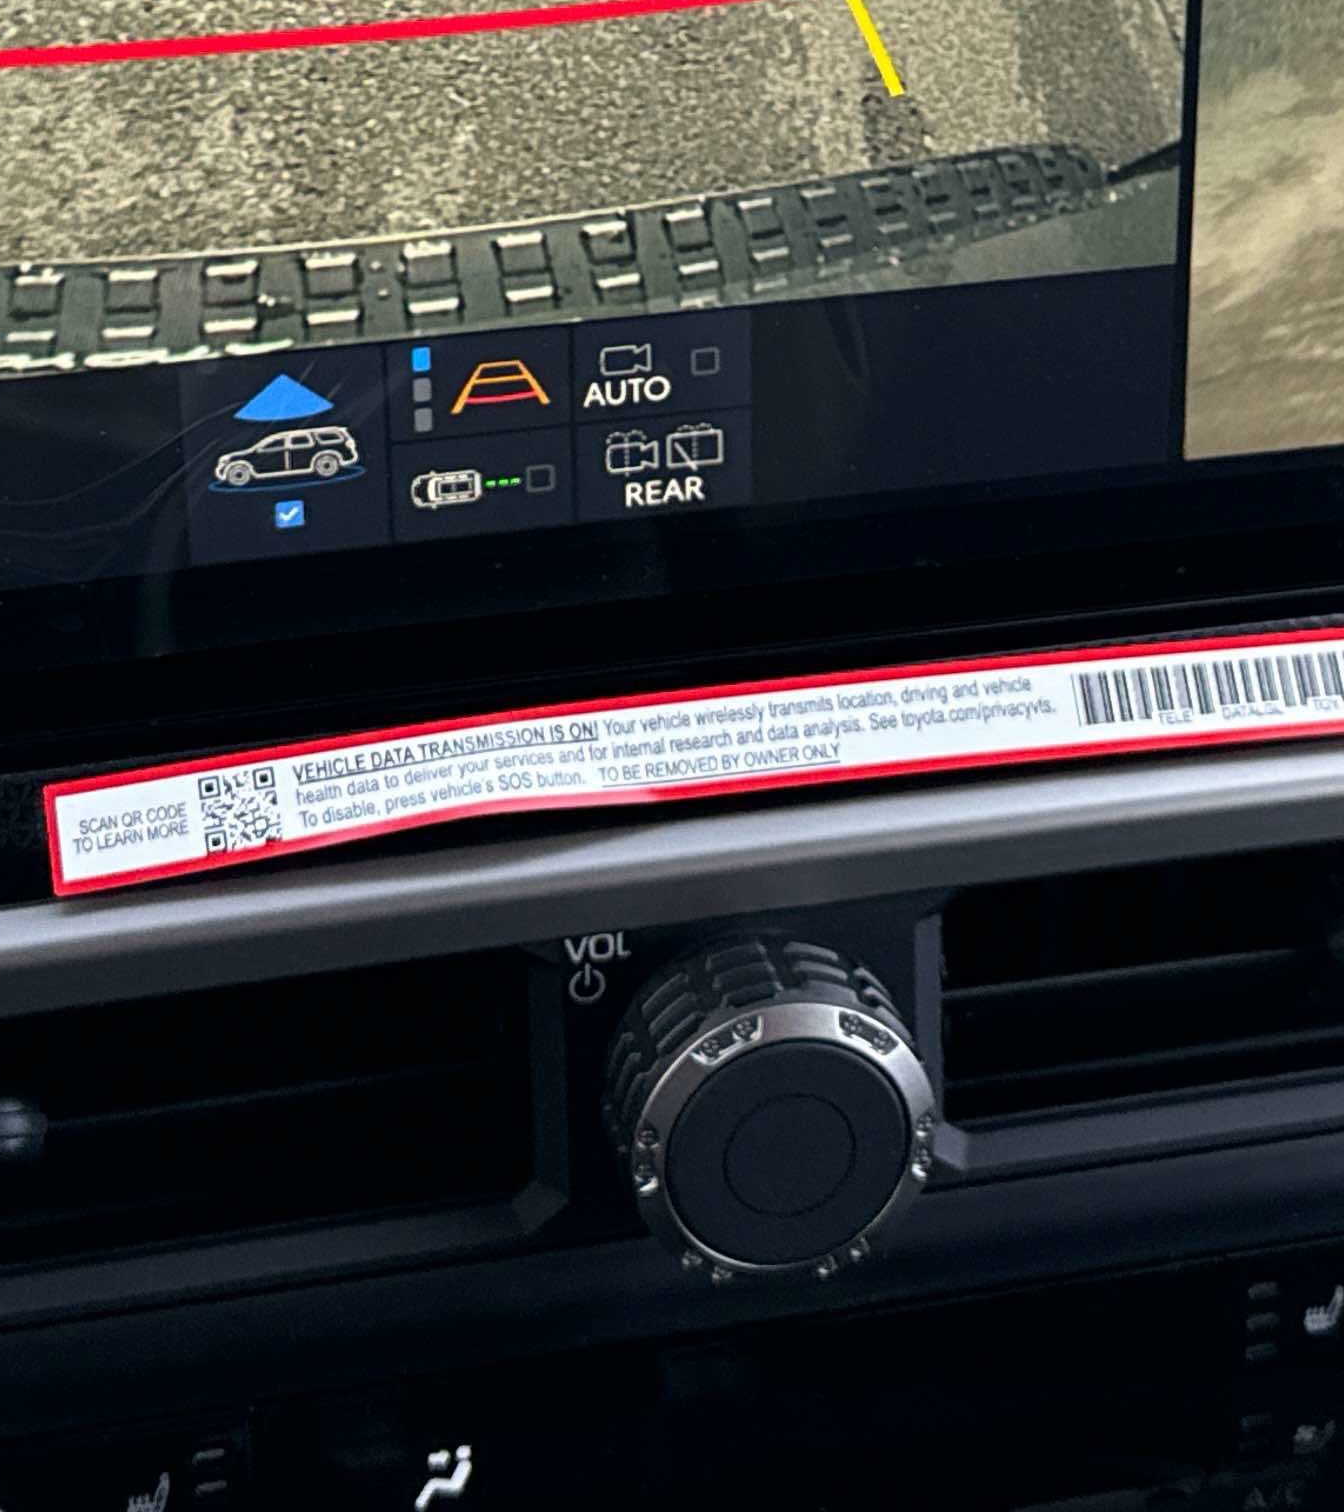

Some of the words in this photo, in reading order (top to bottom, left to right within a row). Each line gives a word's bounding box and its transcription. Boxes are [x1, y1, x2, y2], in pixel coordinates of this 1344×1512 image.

[583, 375, 672, 409] AUTO
[624, 475, 705, 509] REAR
[292, 753, 366, 782] VEHICLE
[371, 746, 416, 768] DATA
[417, 727, 545, 760] TRANSMISSION
[550, 724, 564, 741] IS
[569, 719, 598, 738] ON!
[602, 719, 636, 736] Your
[640, 712, 691, 732] vehicle
[694, 703, 764, 726] wirelessly
[768, 695, 834, 717] transmits
[837, 690, 897, 710] location,
[901, 685, 948, 704] driving
[952, 680, 979, 698] and
[983, 676, 1032, 695] vehicle
[296, 785, 342, 806] health
[347, 778, 380, 797] data
[384, 773, 399, 789] to
[405, 764, 453, 786] deliver
[457, 758, 489, 778] your
[496, 750, 554, 769] services
[559, 746, 585, 764] and
[588, 744, 607, 762] for
[613, 738, 666, 759] internal
[670, 731, 732, 753] research
[736, 726, 763, 745] and
[768, 723, 799, 742] data
[803, 719, 865, 739] analysis.
[868, 712, 898, 731] See
[299, 810, 318, 829] To
[322, 800, 381, 824] disable,
[385, 791, 427, 818] press
[430, 778, 494, 802] vehicle's
[498, 771, 533, 791] SOS
[537, 770, 586, 787] button.
[598, 767, 619, 782] TO
[622, 764, 641, 782] BE
[645, 756, 718, 778] REMOVED
[722, 752, 741, 770] BY
[744, 746, 799, 767] OWNER
[802, 742, 841, 760] ONLY
[79, 814, 119, 835] SCAN
[121, 809, 144, 828] QR
[146, 802, 188, 824] CODE
[73, 837, 93, 855] TO
[97, 827, 143, 851] LEARN
[147, 818, 189, 839] MORE
[563, 932, 632, 964] VOL
